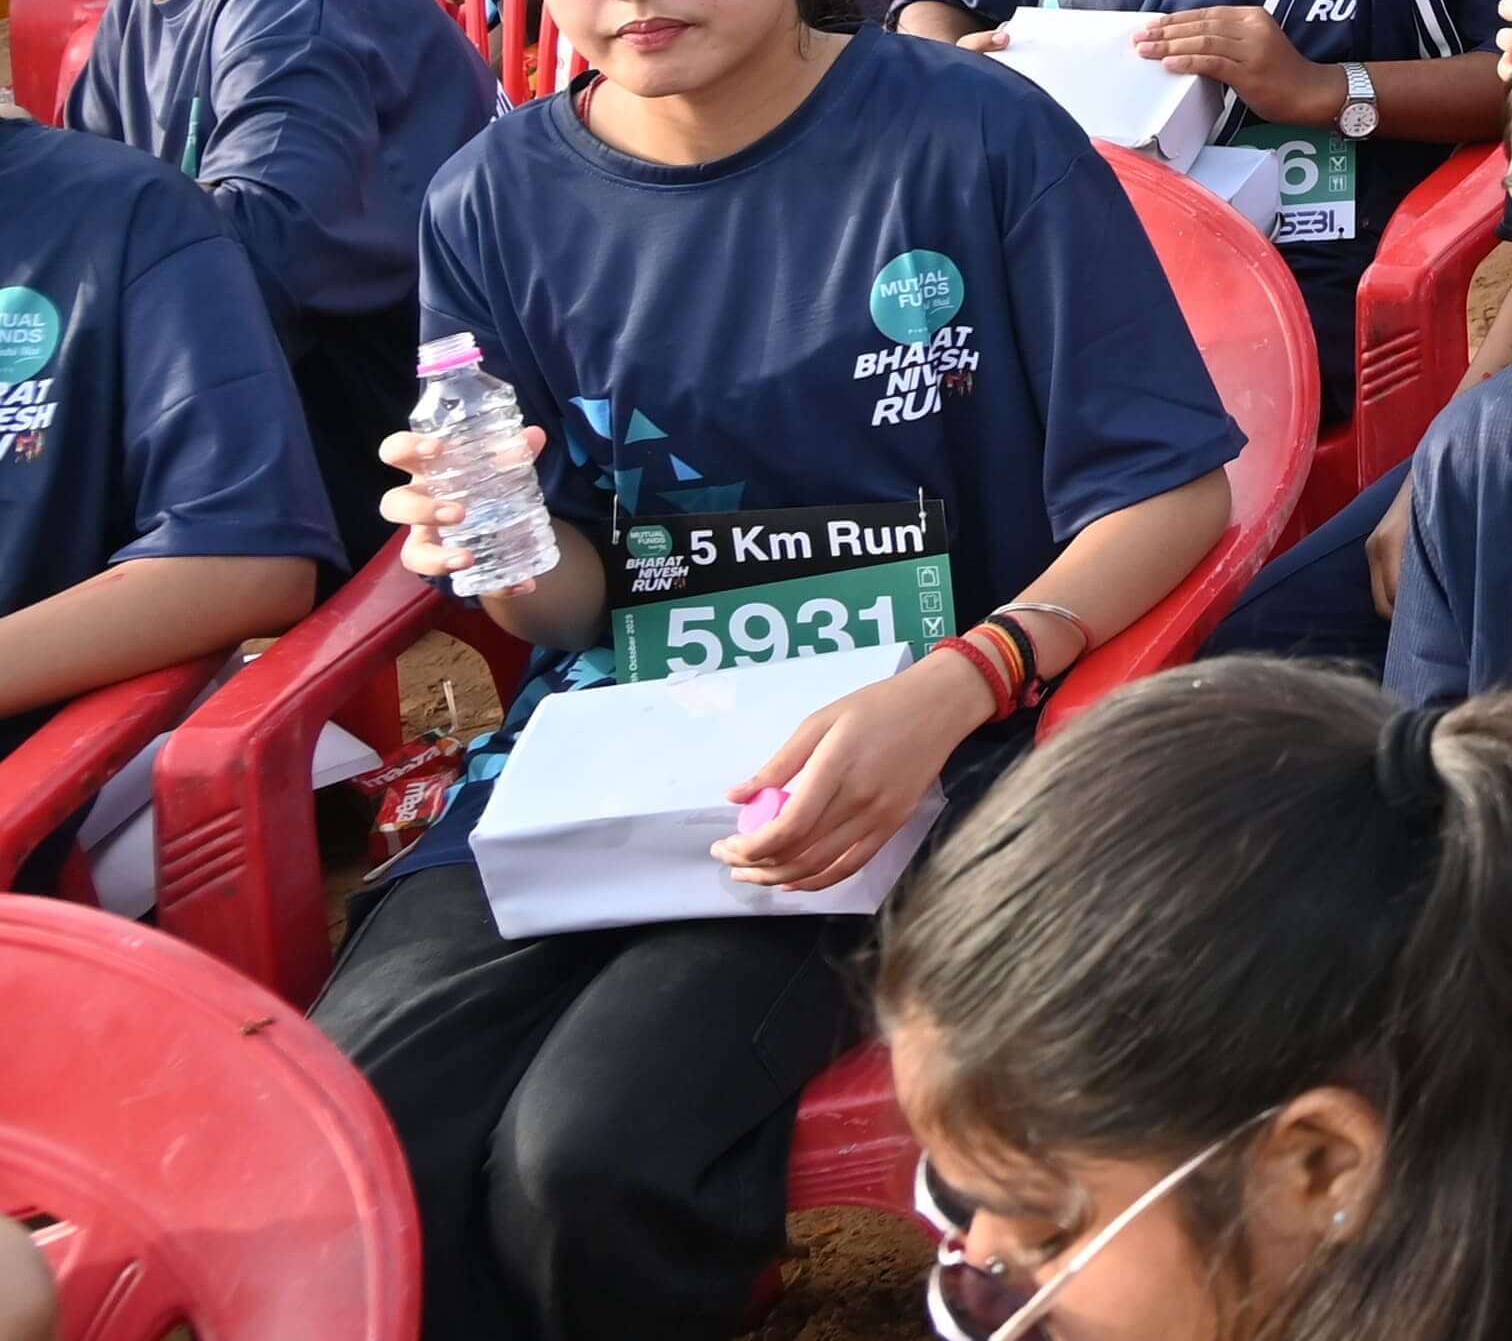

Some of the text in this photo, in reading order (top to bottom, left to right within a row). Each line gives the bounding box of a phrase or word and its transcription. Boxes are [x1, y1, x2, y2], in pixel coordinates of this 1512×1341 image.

[1278, 210, 1337, 236] SEBI
[689, 519, 925, 565] 5 Km Run
[626, 555, 685, 571] BHARAT
[638, 566, 690, 580] NIVESH
[631, 579, 672, 593] RUN
[665, 594, 898, 677] 5931
